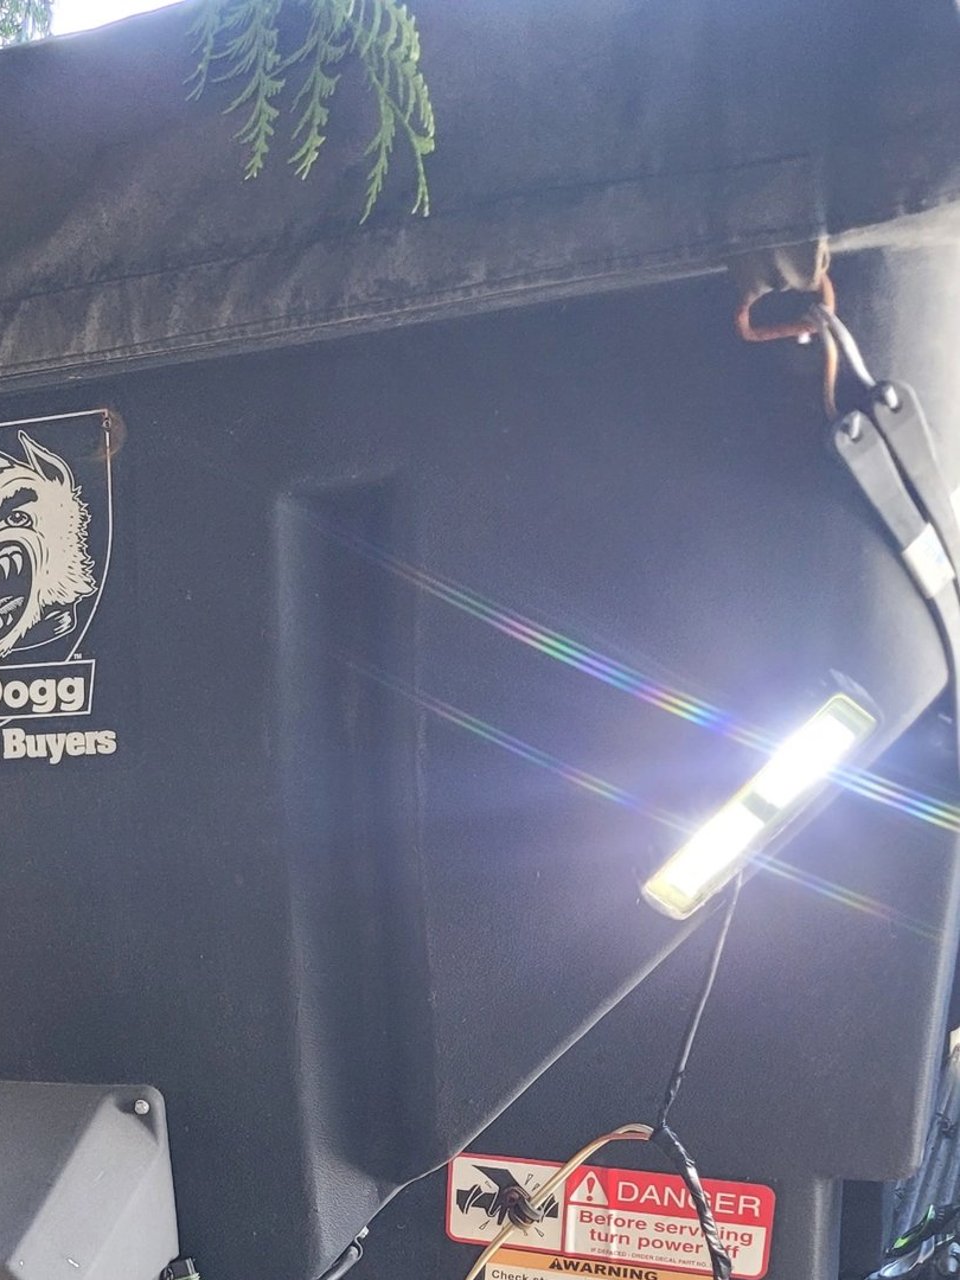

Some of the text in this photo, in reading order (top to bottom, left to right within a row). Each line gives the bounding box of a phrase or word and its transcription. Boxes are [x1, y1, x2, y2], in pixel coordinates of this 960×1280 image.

[2, 728, 117, 764] Buyers
[579, 1210, 753, 1247] Before serving
[589, 1228, 630, 1245] turn
[638, 1236, 703, 1255] power
